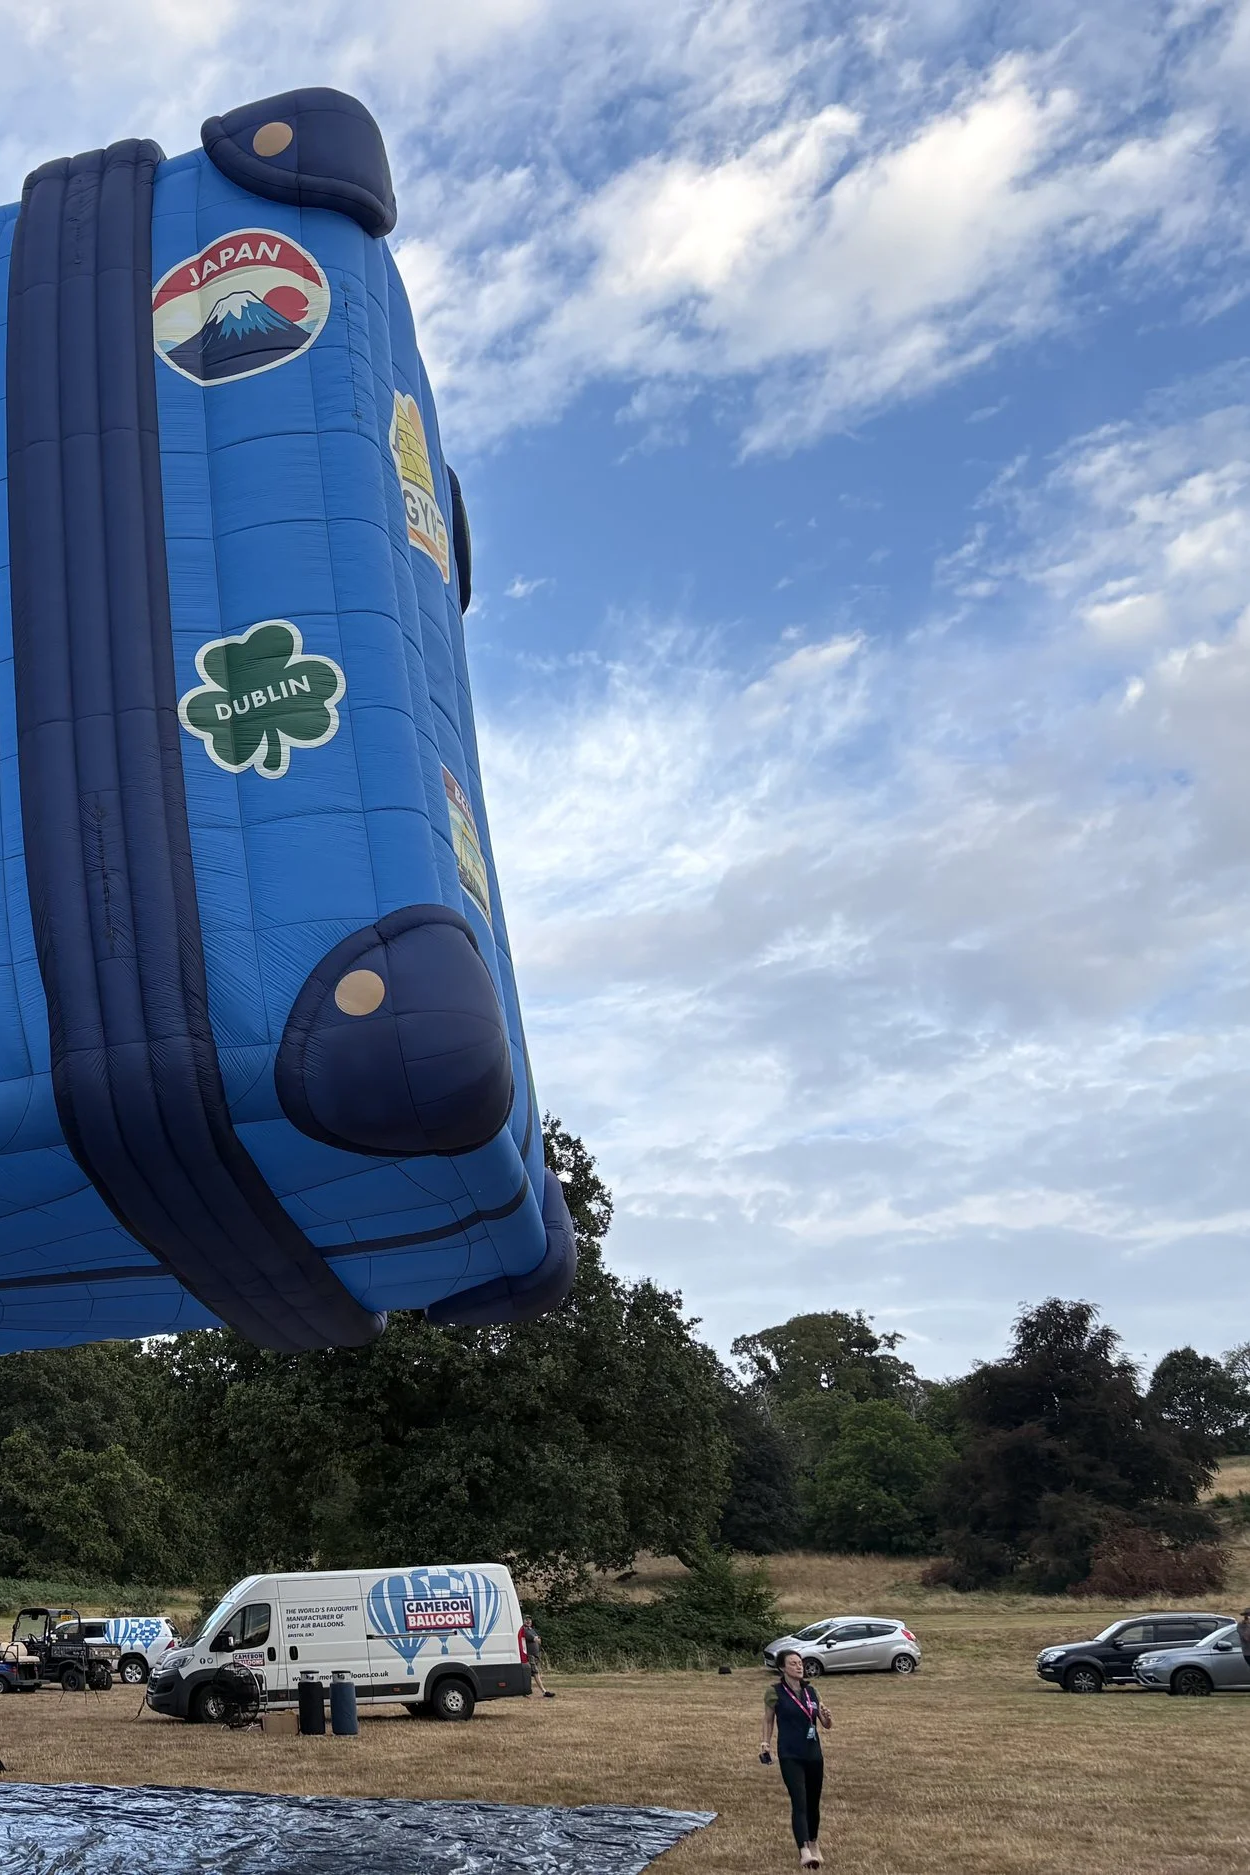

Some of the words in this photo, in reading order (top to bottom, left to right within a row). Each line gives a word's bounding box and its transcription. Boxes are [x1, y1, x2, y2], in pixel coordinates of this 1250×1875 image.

[189, 241, 281, 287] JAPAN
[215, 674, 311, 721] DUBLIN
[406, 1600, 470, 1613] CAMERON
[312, 1621, 346, 1629] BALLOONS.
[407, 1613, 471, 1627] BALLOONS
